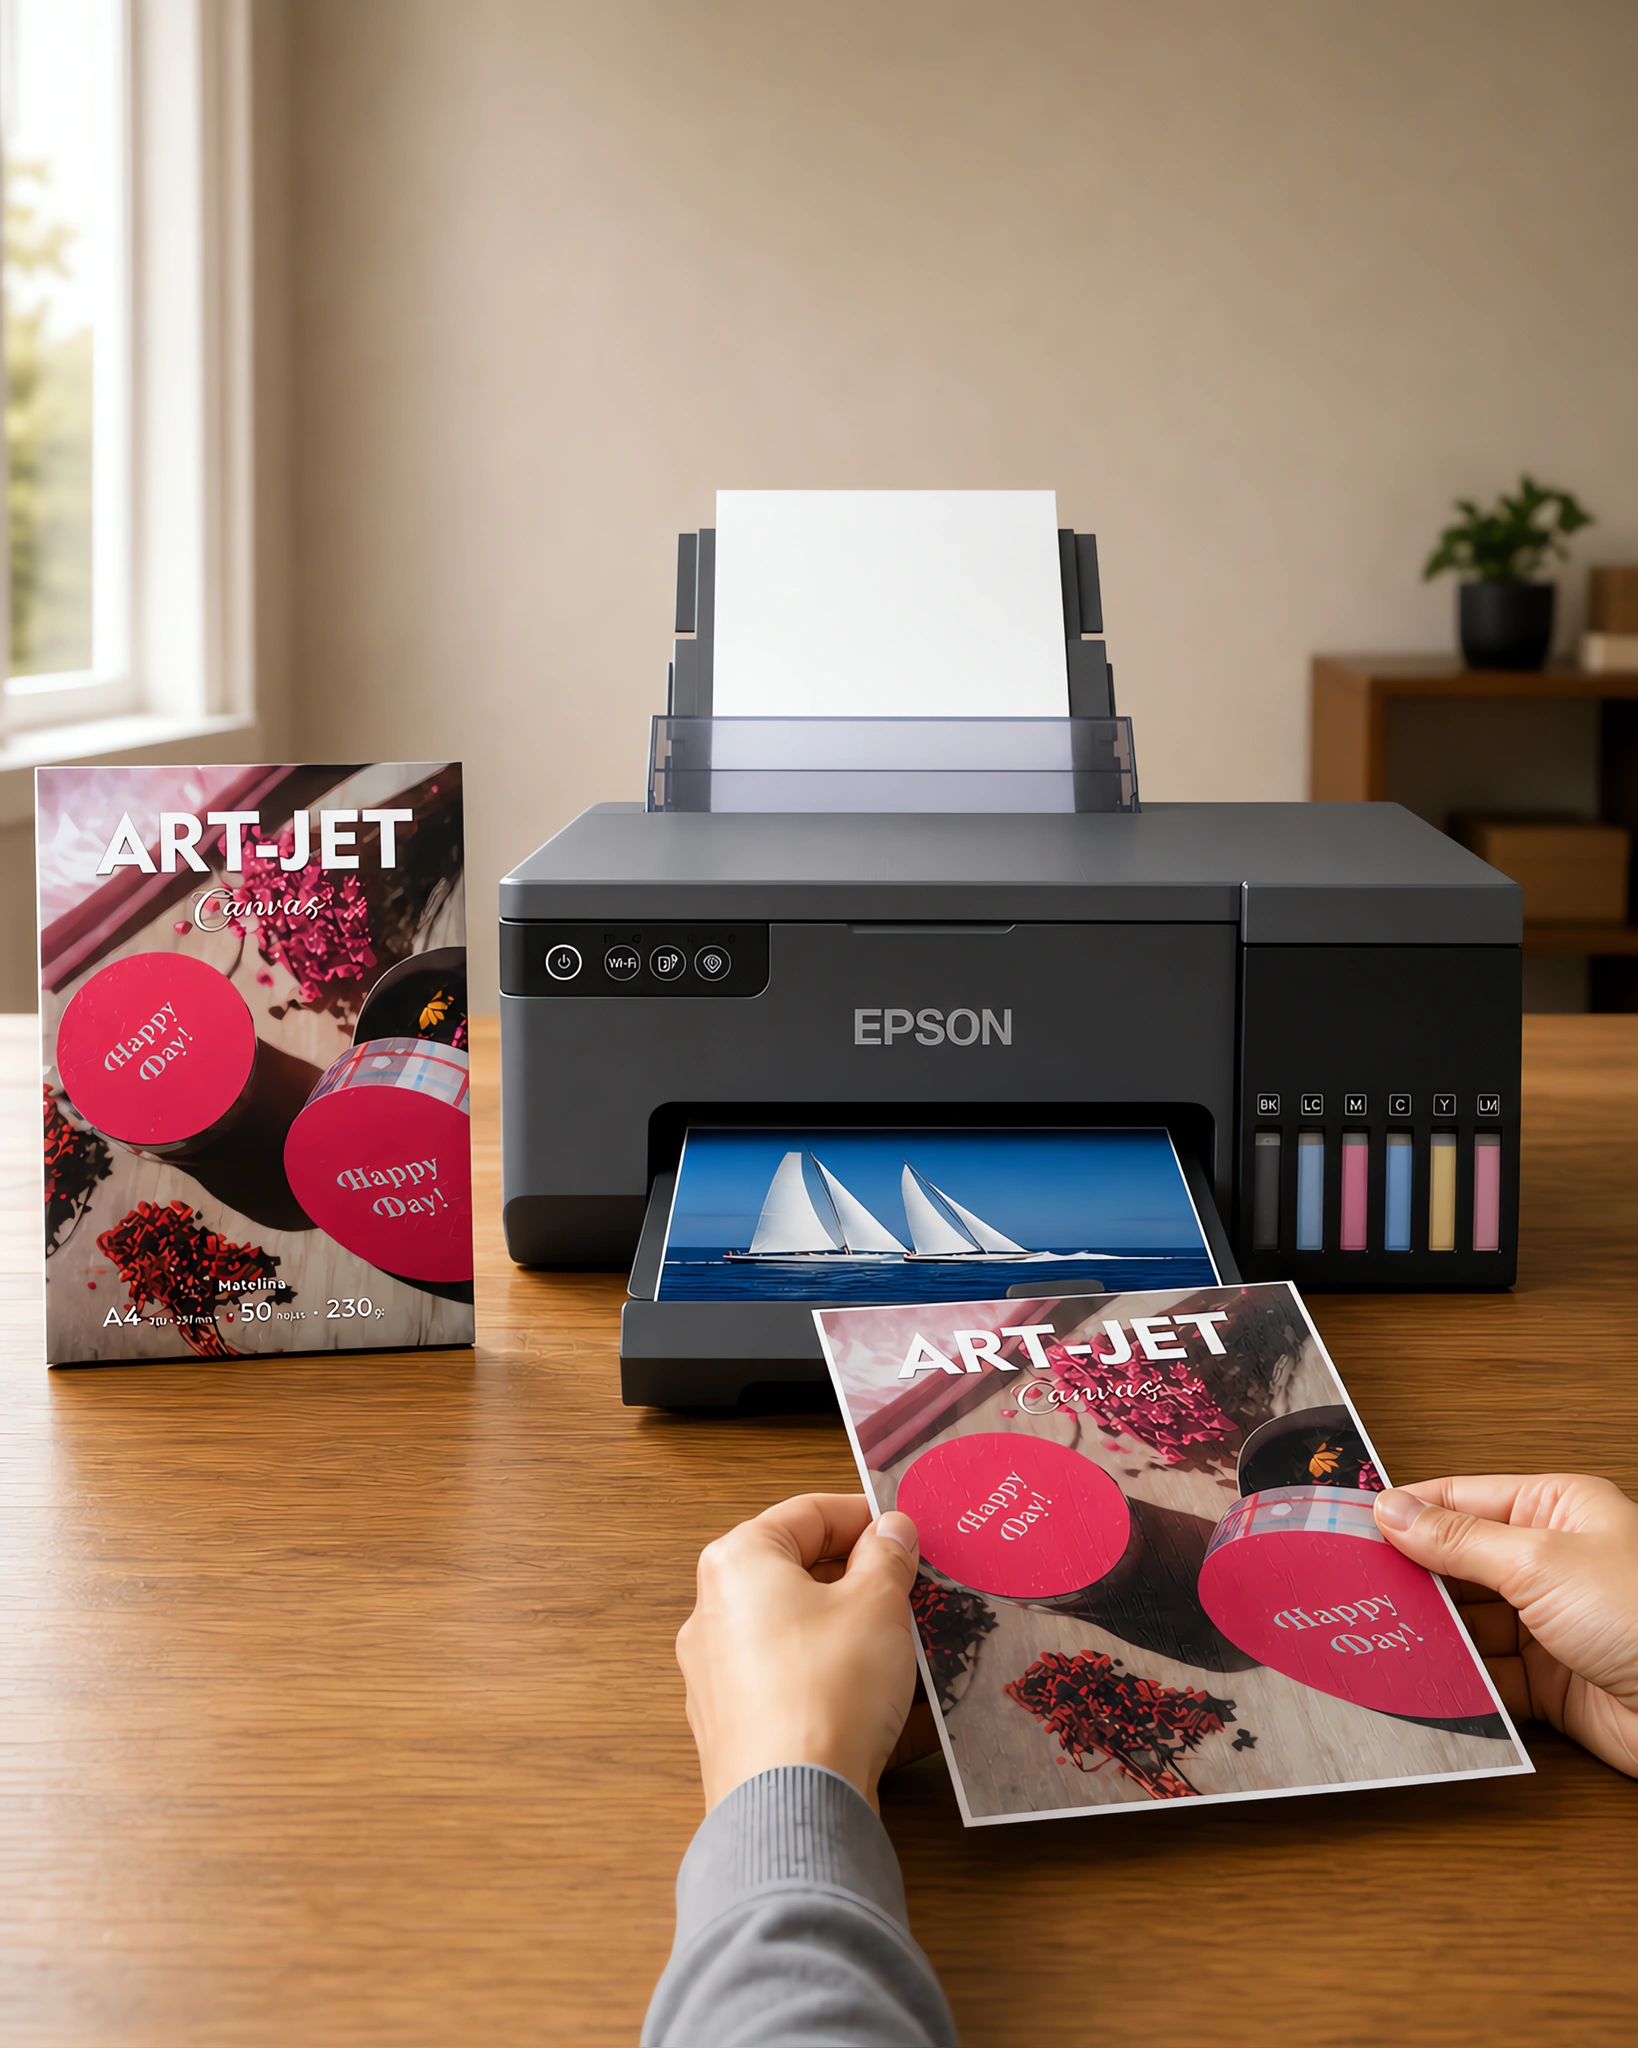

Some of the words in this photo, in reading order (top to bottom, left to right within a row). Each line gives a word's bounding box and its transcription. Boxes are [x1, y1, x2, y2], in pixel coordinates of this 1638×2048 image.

[95, 808, 413, 875] ART-JET
[191, 887, 327, 932] Canvas
[104, 1001, 178, 1071] Happy
[854, 1008, 1012, 1046] EPSON
[139, 1026, 193, 1080] Day!
[1260, 1099, 1278, 1111] BK
[1303, 1099, 1321, 1111] LC
[1350, 1099, 1362, 1111] M
[1395, 1099, 1406, 1111] C
[1439, 1099, 1450, 1111] Y
[336, 1157, 437, 1191] Happy
[373, 1187, 448, 1218] Day!
[102, 1305, 142, 1328] A4
[240, 1301, 273, 1323] 50
[897, 1310, 1229, 1380] ART-JET
[1010, 1376, 1162, 1416] Canvas
[957, 1470, 1027, 1533] Happy
[1000, 1491, 1052, 1541] Day!
[1273, 1594, 1398, 1631] Happy
[1330, 1622, 1424, 1656] Day!
